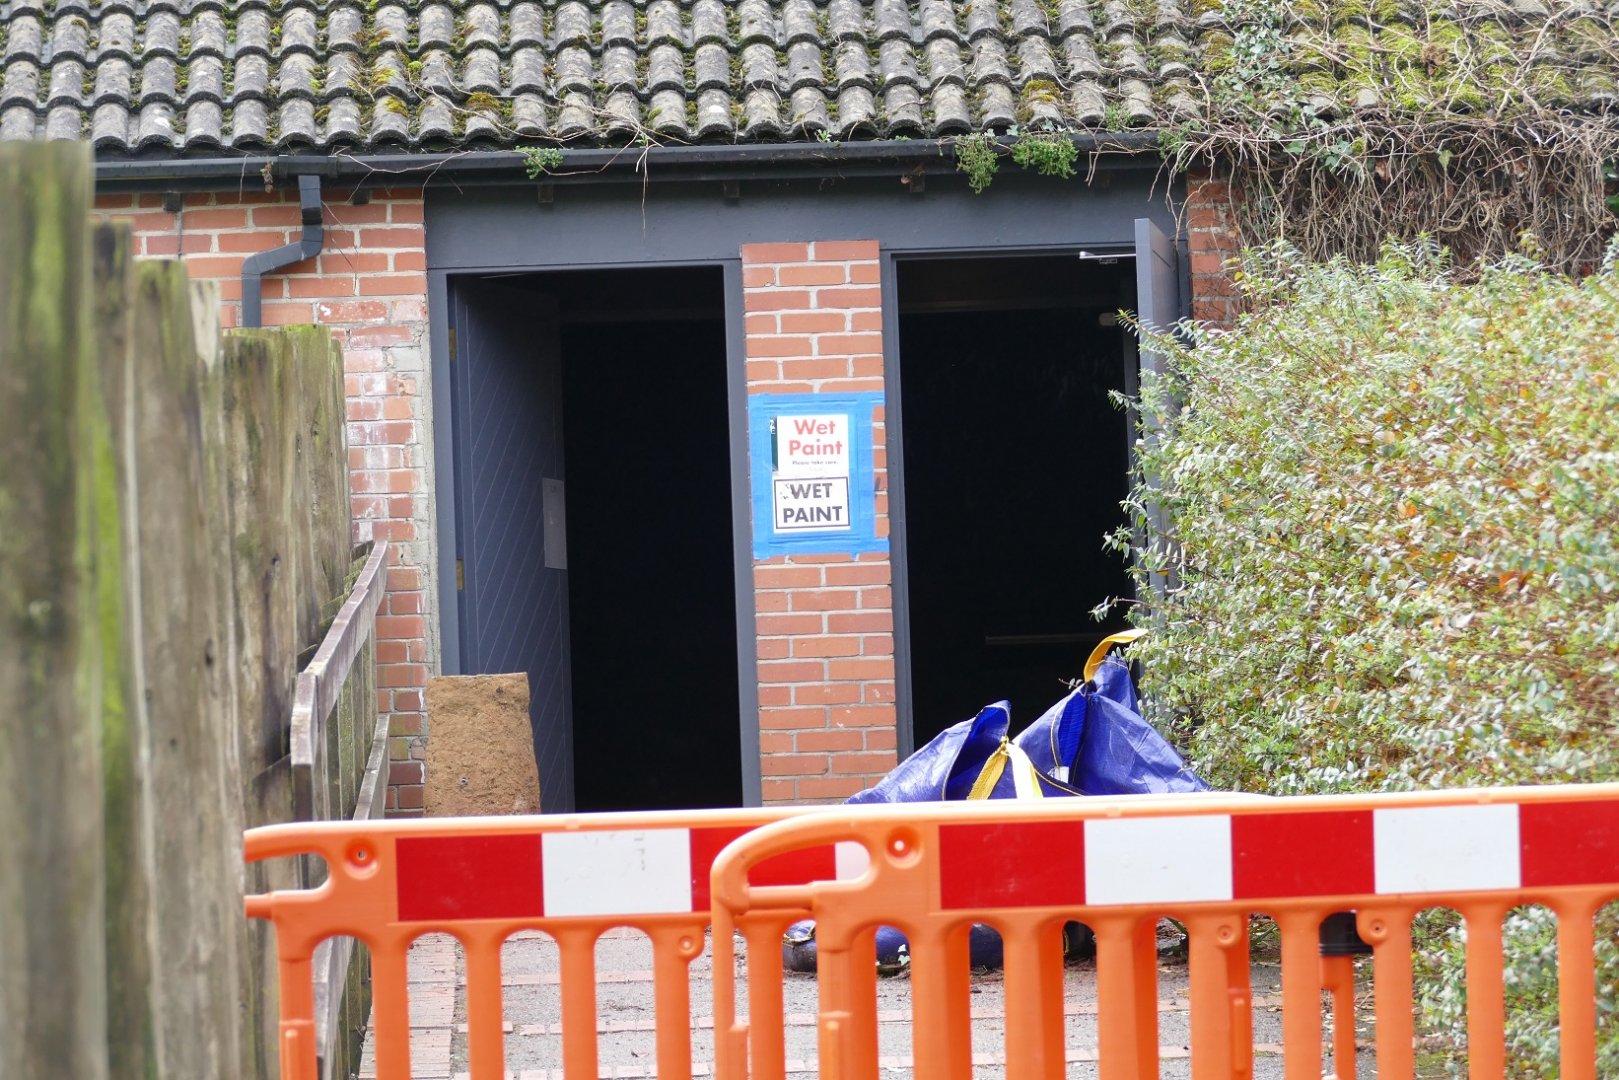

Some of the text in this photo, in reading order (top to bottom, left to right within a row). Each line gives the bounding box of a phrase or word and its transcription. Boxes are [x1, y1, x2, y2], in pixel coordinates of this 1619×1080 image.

[794, 419, 836, 435] Wet
[789, 439, 843, 456] Paint
[790, 483, 833, 499] WET
[783, 506, 843, 523] PAINT
